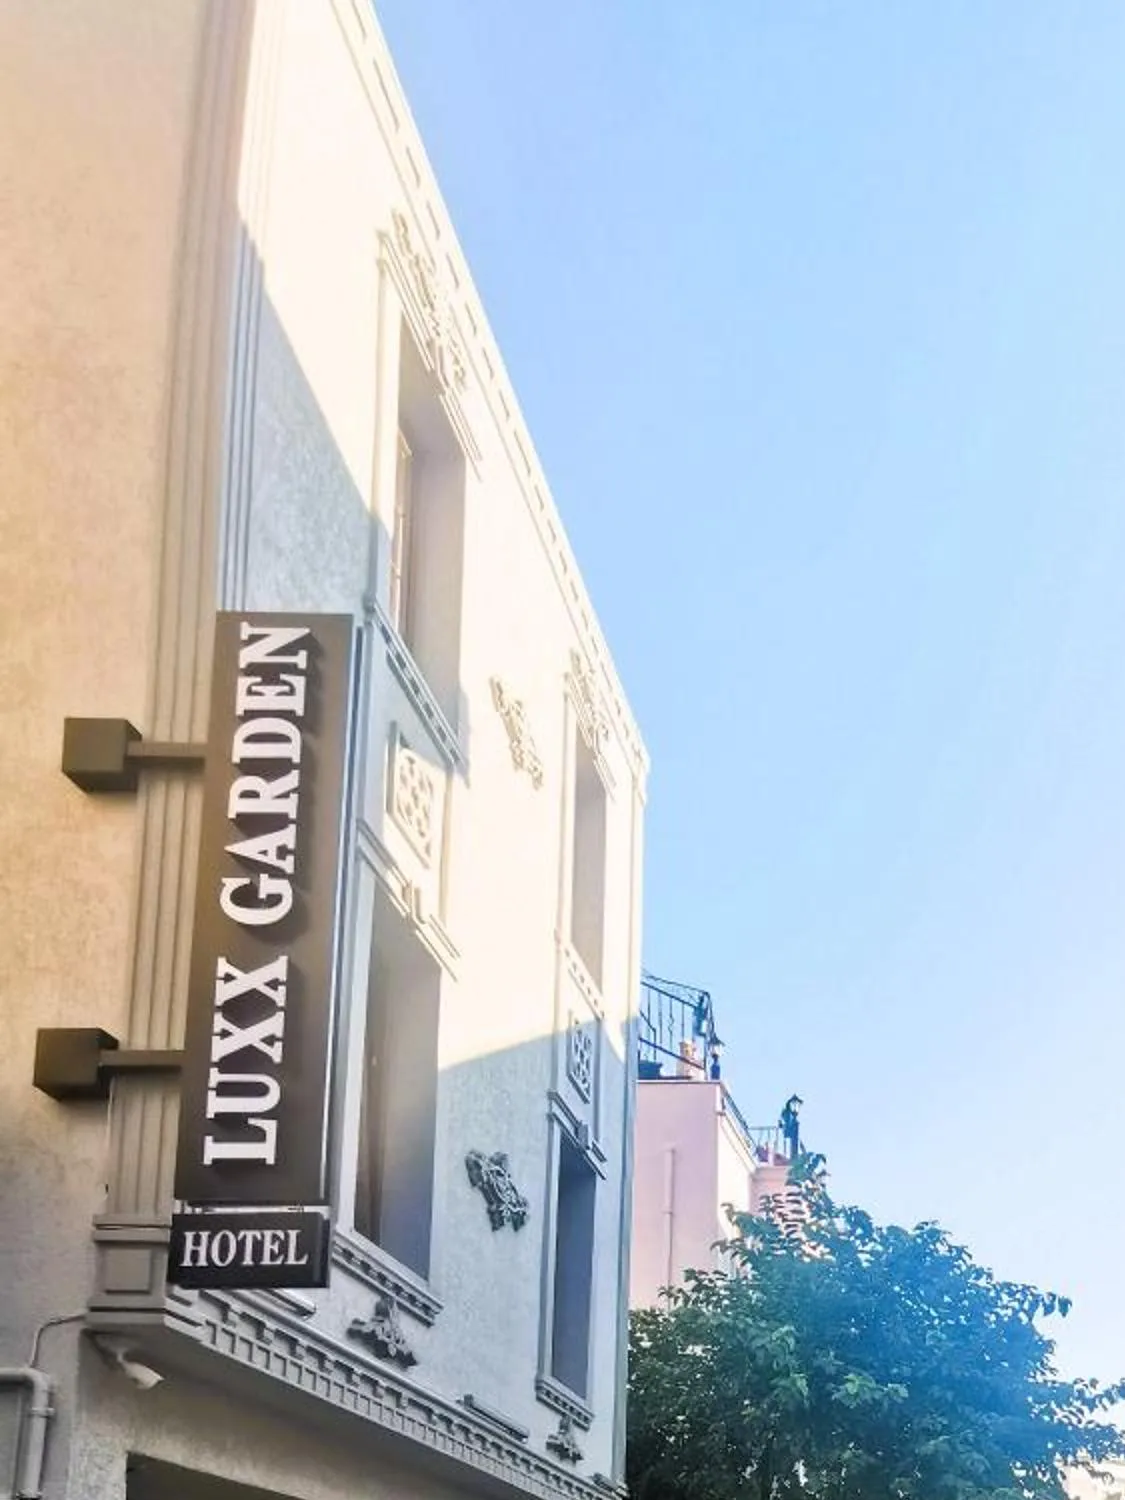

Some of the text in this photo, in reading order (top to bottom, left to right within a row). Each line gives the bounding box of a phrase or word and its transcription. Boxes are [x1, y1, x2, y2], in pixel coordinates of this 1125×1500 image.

[203, 621, 311, 1168] LUXX GARDEN
[179, 1229, 309, 1267] HOTEL
